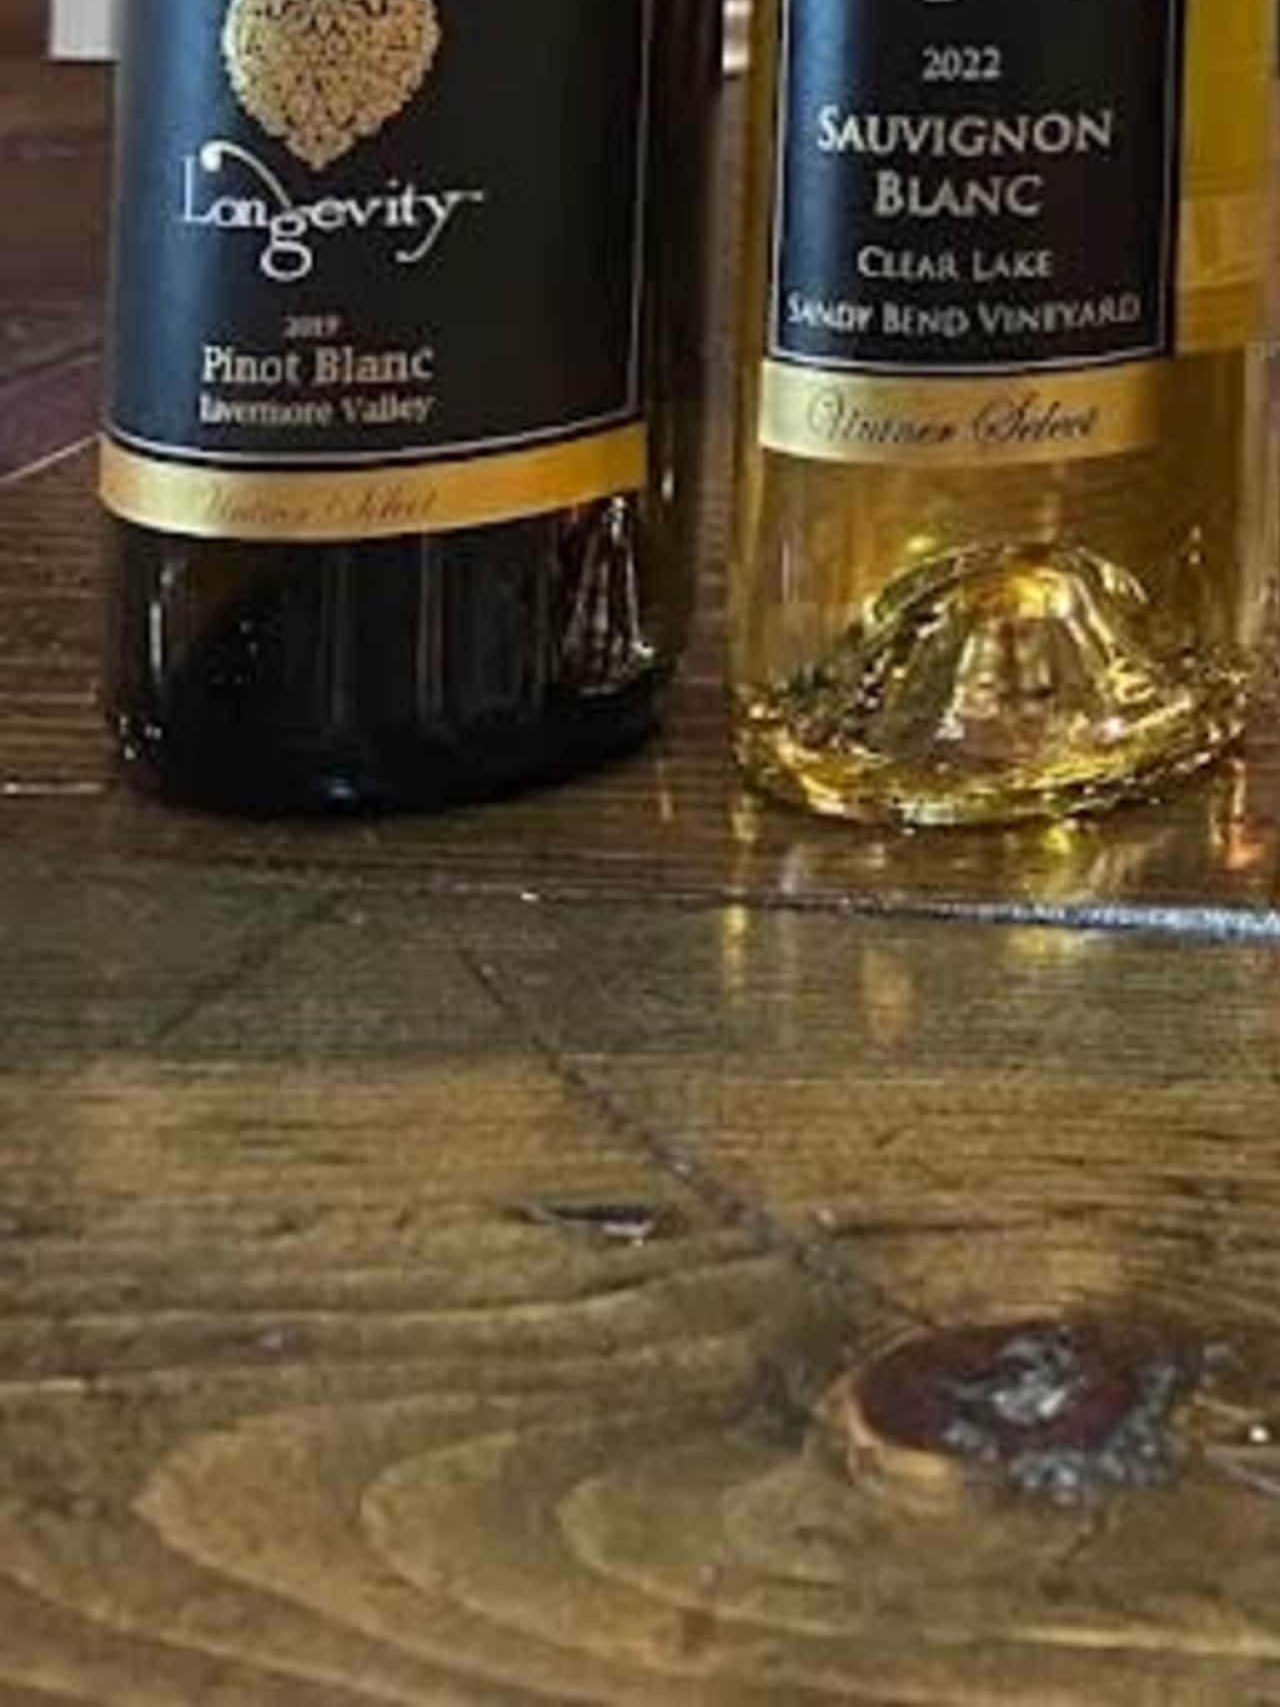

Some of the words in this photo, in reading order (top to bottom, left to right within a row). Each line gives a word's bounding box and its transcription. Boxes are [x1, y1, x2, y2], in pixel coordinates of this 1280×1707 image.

[922, 47, 1002, 81] 2022
[816, 104, 1113, 157] SAUVIGNON
[180, 140, 484, 281] Longevity
[873, 170, 1045, 218] BLANC
[857, 245, 958, 281] CLEAR
[972, 248, 1053, 283] LAKE
[202, 343, 302, 385] Pinot
[312, 345, 435, 385] Blanc
[340, 391, 437, 425] Valley
